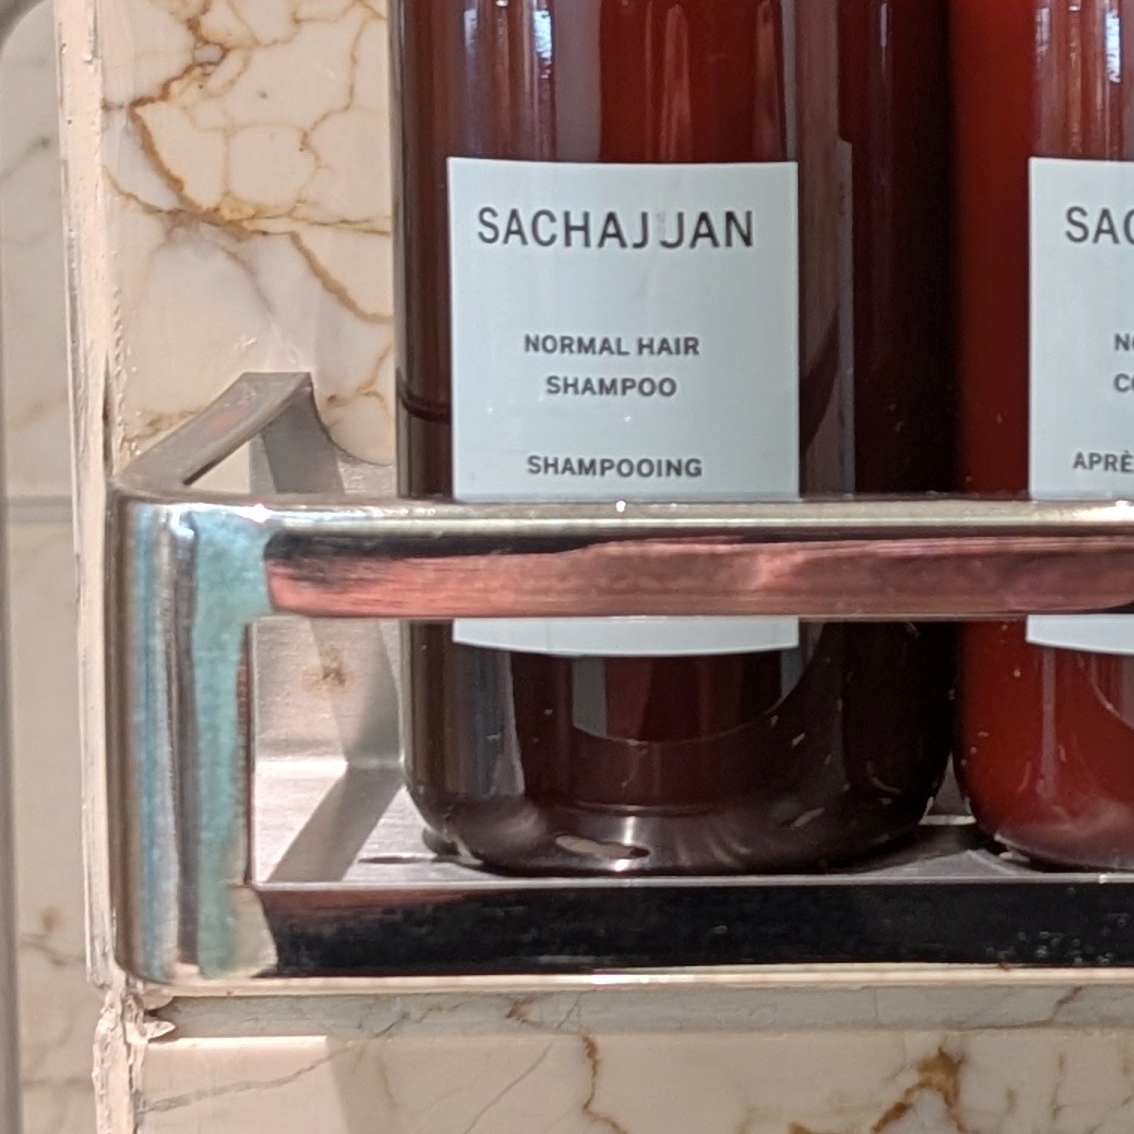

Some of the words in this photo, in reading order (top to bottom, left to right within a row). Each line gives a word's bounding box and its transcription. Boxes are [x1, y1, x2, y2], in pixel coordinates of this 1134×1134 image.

[523, 333, 630, 357] NORMAL
[637, 336, 701, 357] HAIR
[545, 375, 678, 397] SHAMPOO
[526, 455, 704, 478] SHAMPOOING
